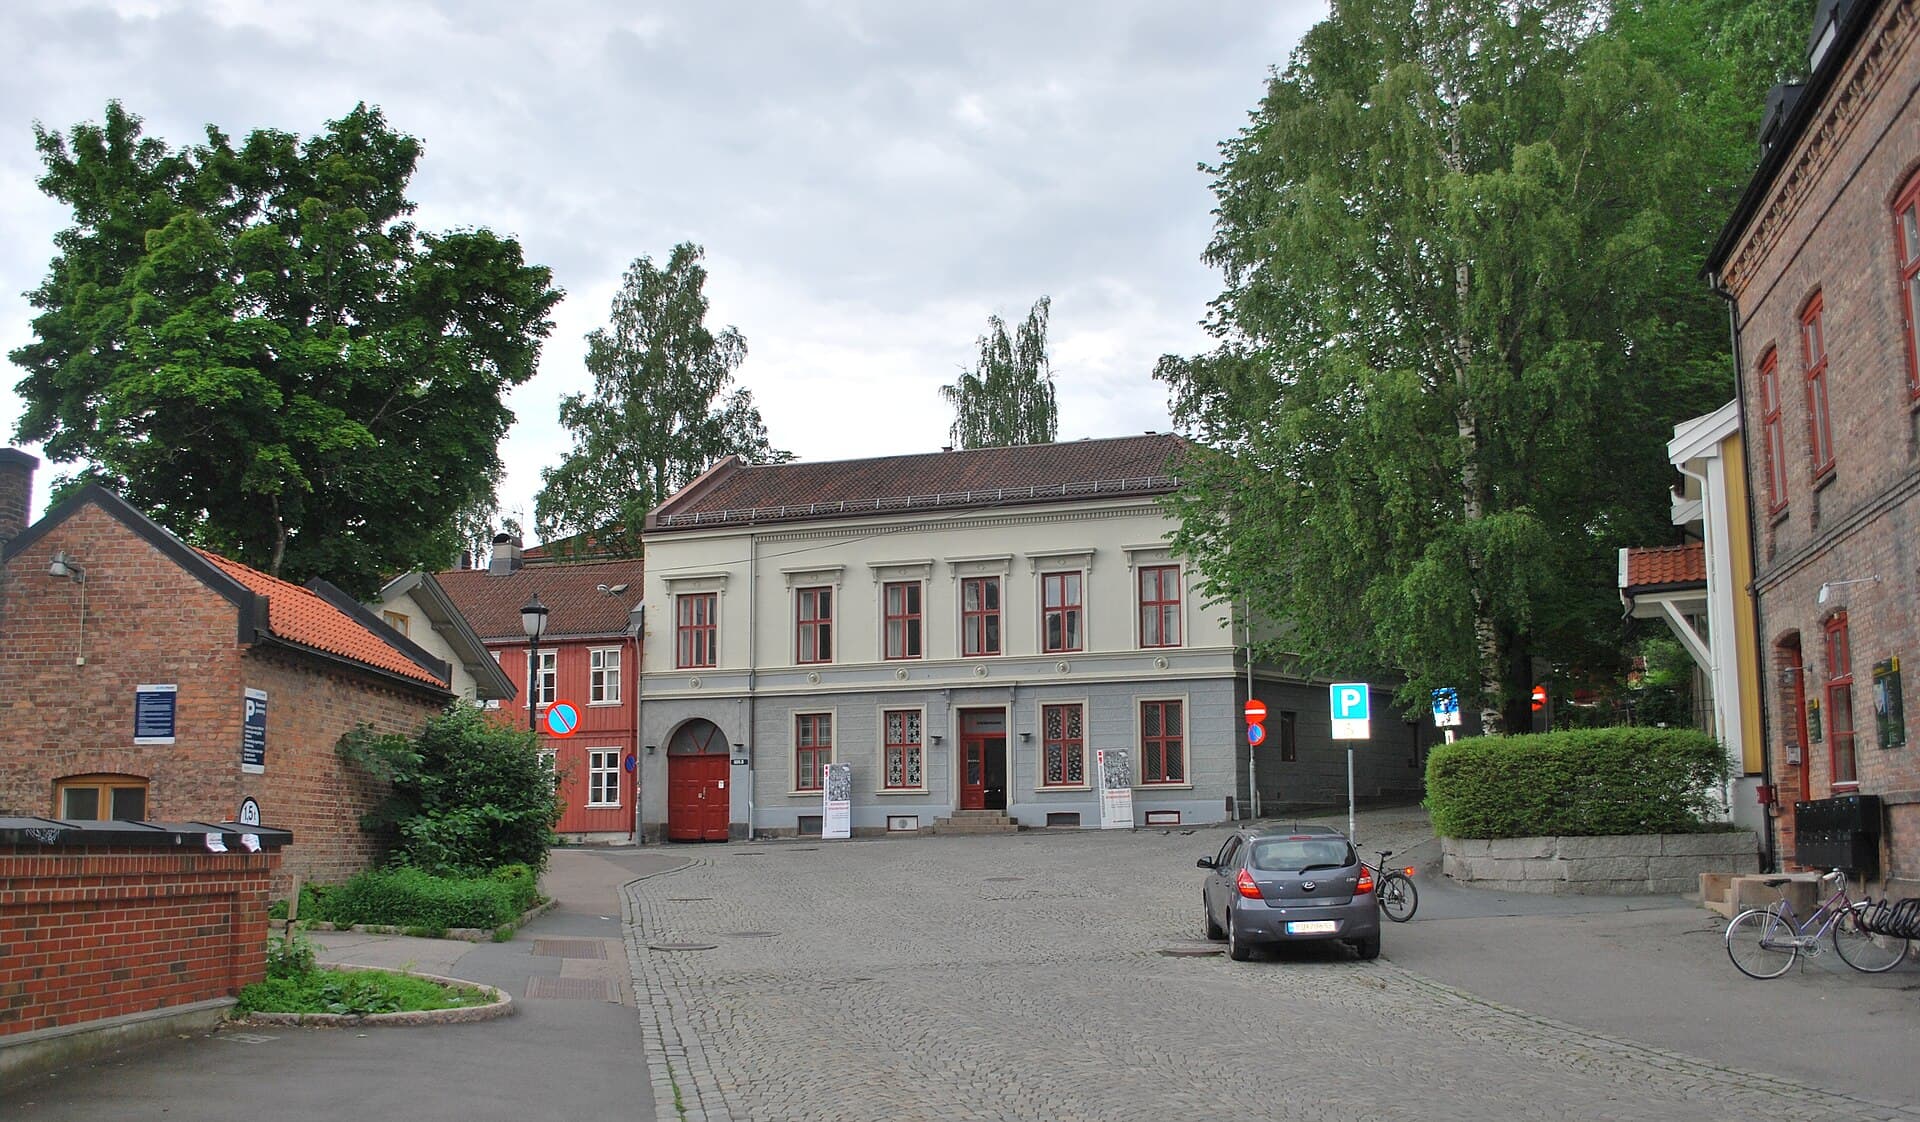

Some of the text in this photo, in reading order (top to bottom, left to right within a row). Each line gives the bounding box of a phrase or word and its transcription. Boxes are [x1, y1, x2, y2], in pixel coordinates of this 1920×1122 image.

[245, 699, 256, 722] P
[1341, 688, 1361, 717] P
[244, 805, 254, 823] 1,5
